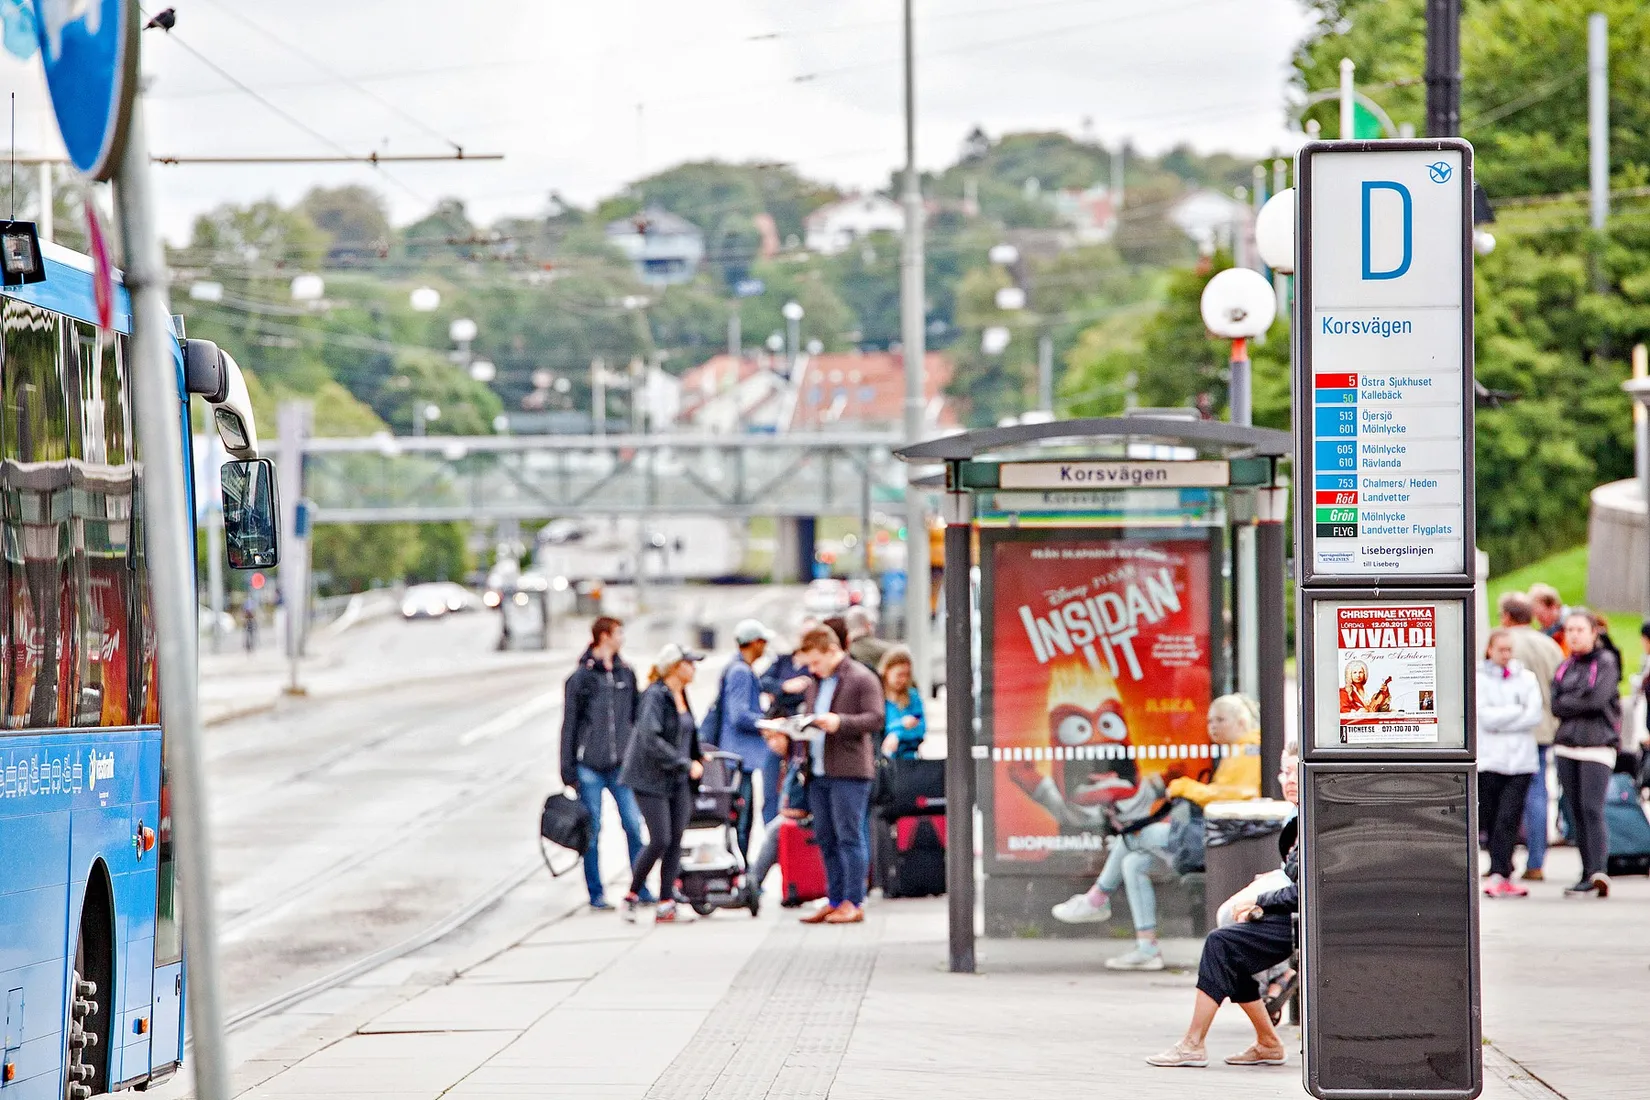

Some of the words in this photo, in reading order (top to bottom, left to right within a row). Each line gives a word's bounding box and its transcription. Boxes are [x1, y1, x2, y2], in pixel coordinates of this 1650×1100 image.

[1361, 180, 1413, 281] D
[1322, 316, 1412, 338] Korsvägen
[1348, 375, 1356, 387] 5
[1361, 375, 1385, 387] Östra
[1389, 376, 1432, 388] Sjukhuset
[1342, 393, 1354, 403] 50
[1361, 390, 1403, 400] Kallebäck
[1339, 411, 1353, 421] 513
[1362, 408, 1393, 422] Öjersjö
[1339, 424, 1353, 434] 601
[1362, 424, 1406, 435] Mölnlycke
[1337, 445, 1353, 455] 605
[1362, 445, 1406, 455] Mölnlycke
[1339, 457, 1353, 468] 610
[1362, 458, 1402, 468] Rävlanda
[1060, 466, 1168, 485] Korsvägen
[1338, 478, 1354, 488] 753
[1362, 478, 1406, 489] Chalmers/
[1409, 478, 1438, 488] Heden
[1335, 493, 1355, 504] Röd
[1362, 492, 1411, 502] Landvetter
[1330, 509, 1355, 522] Grön
[1361, 512, 1406, 523] Mölnlycke
[1333, 526, 1354, 537] FLYG
[1361, 525, 1409, 535] Landvetter
[1412, 524, 1452, 536] Flygplats
[1361, 546, 1434, 557] Lisebergslinjen
[1373, 561, 1400, 569] Liseberg
[1018, 566, 1183, 664] INSIDAN
[1340, 609, 1397, 619] CHRISTINAE
[1398, 609, 1432, 618] KYRKA
[1340, 627, 1433, 648] VIVALDI
[1083, 627, 1144, 681] UT
